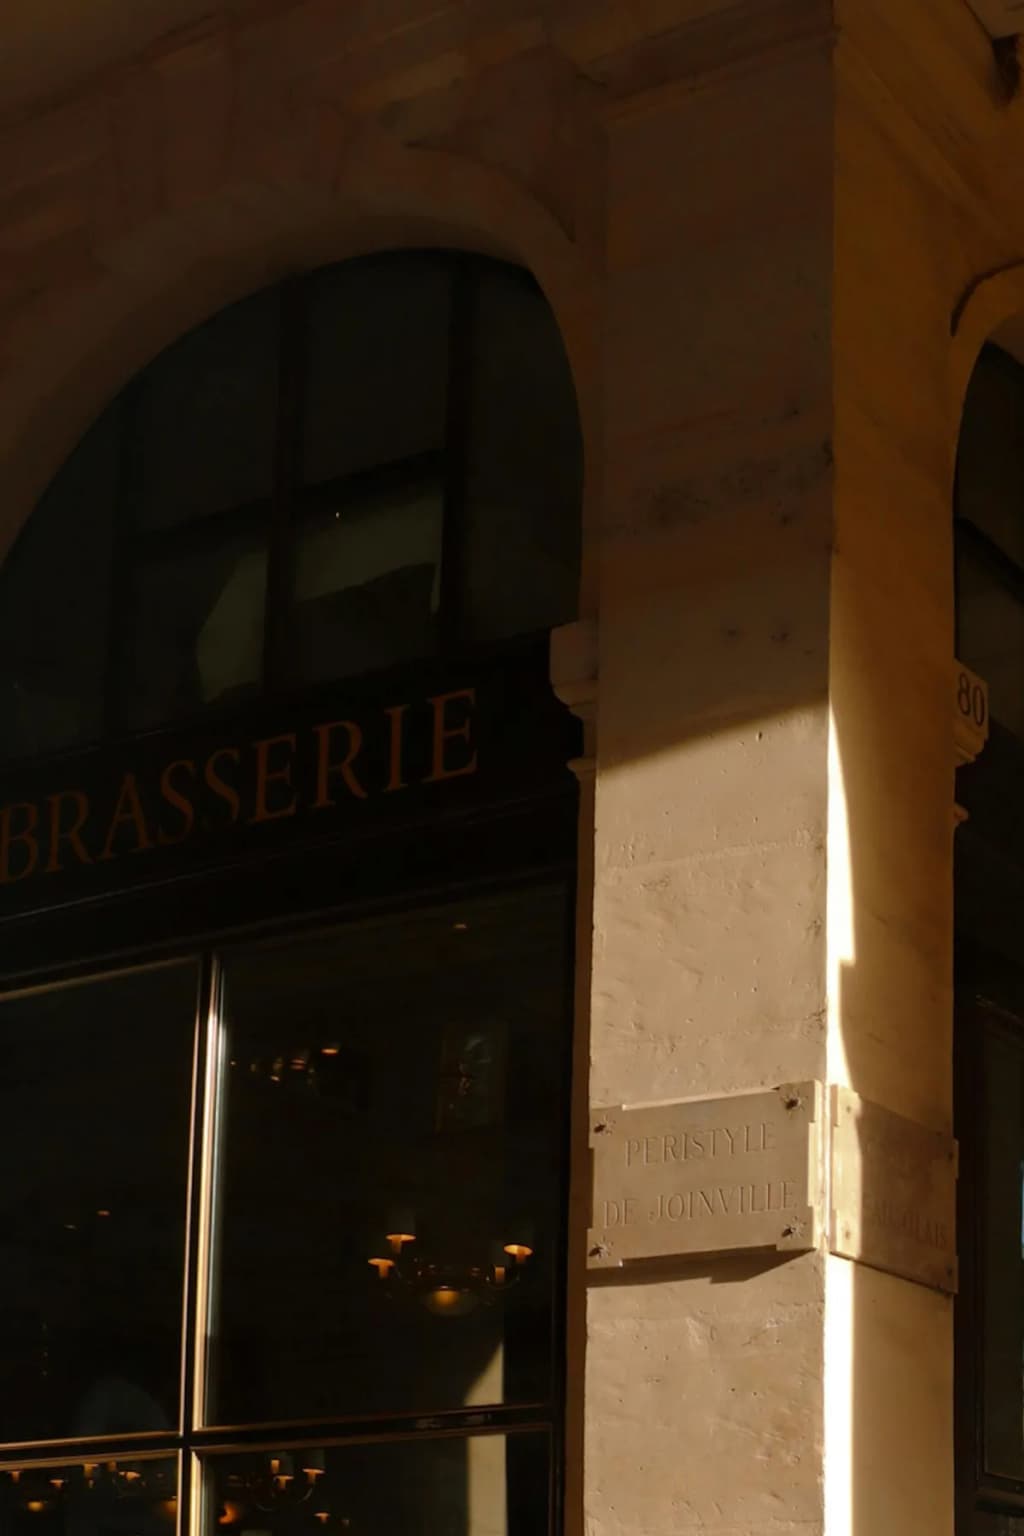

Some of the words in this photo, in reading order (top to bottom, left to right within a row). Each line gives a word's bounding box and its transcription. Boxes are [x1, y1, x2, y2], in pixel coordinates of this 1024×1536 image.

[958, 672, 985, 728] 80
[0, 687, 481, 887] BRASSERIE
[625, 1122, 773, 1168] PERISTYLE
[604, 1198, 636, 1230] DE
[649, 1179, 796, 1224] JOINVILLE
